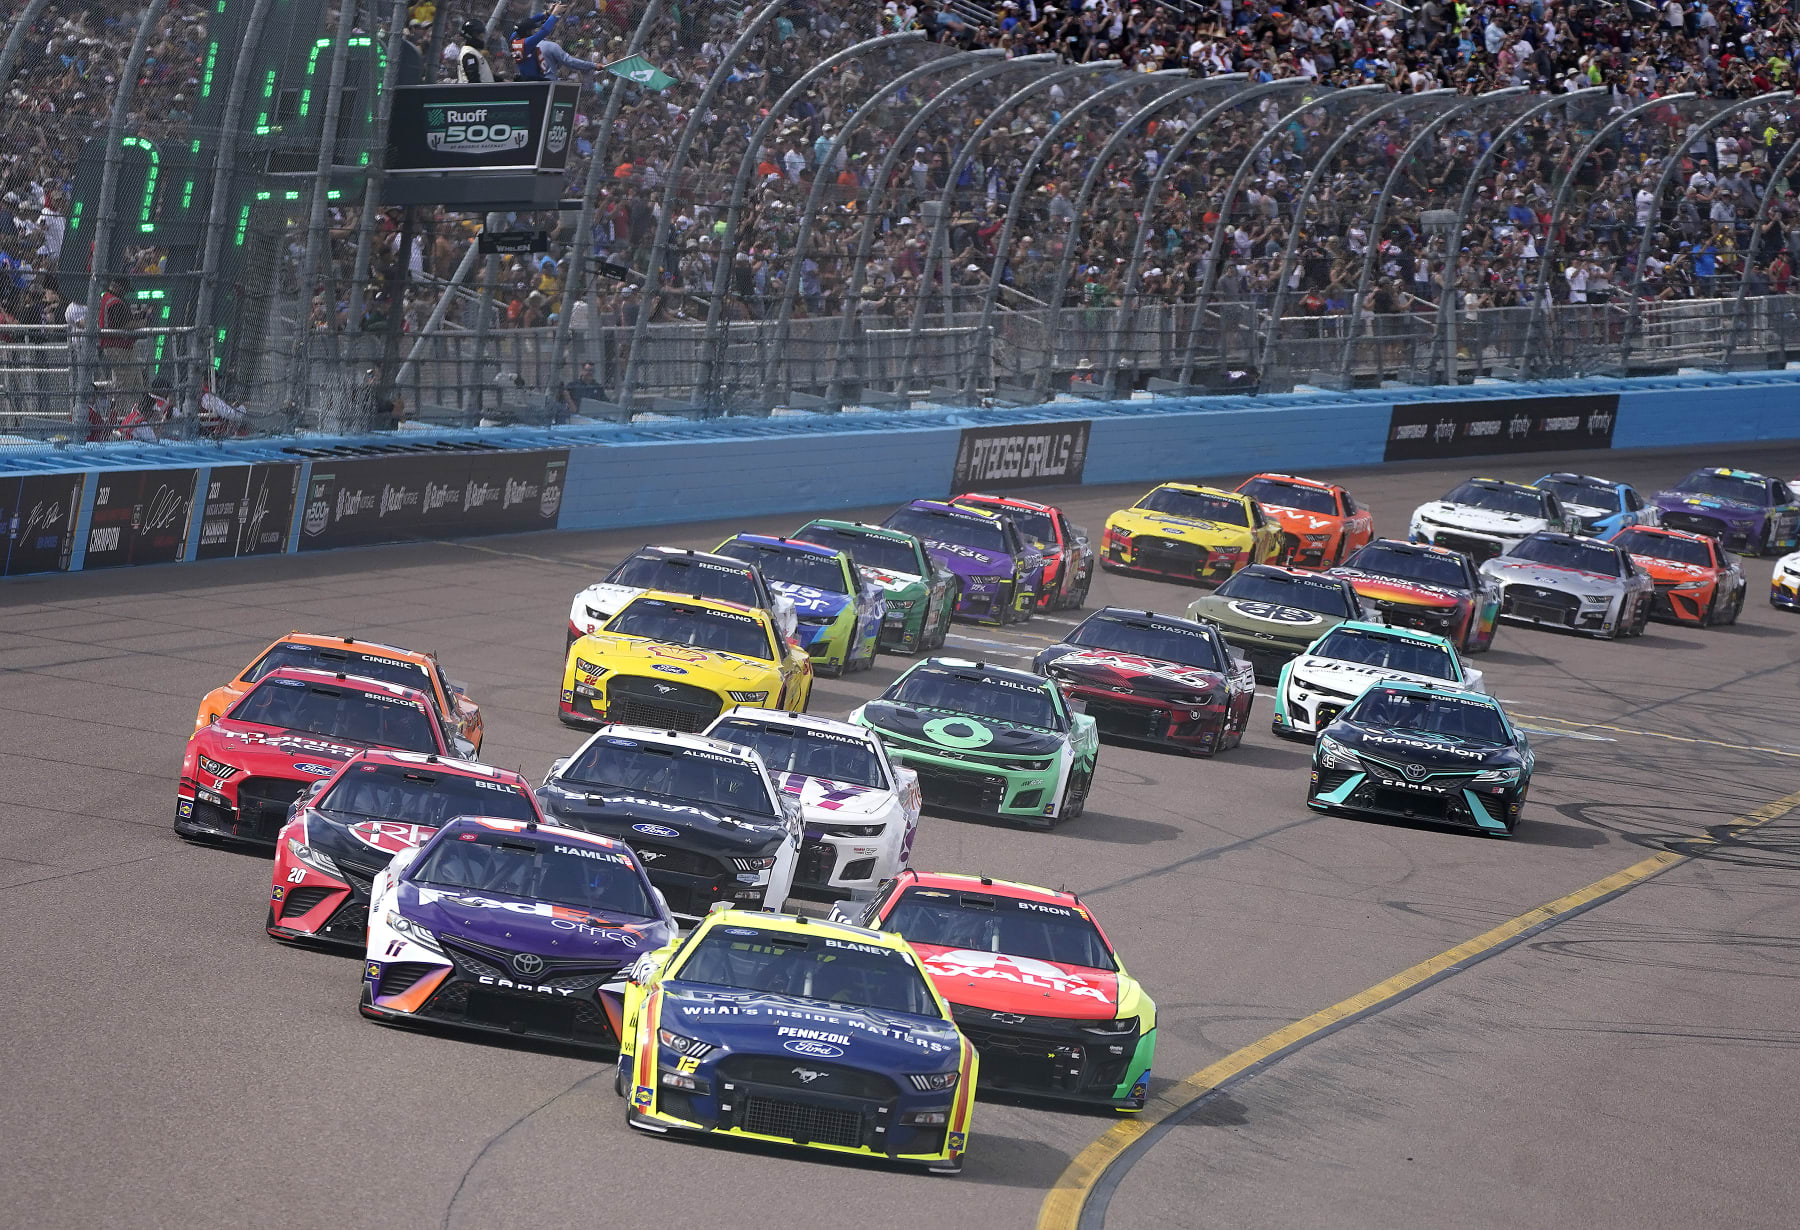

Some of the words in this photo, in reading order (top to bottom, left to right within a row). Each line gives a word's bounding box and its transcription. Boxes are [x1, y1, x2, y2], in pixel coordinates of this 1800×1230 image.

[447, 109, 488, 123] Ruoff
[446, 124, 512, 142] 500
[1020, 434, 1072, 478] GRILLS
[1000, 504, 1032, 514] TRUEX
[949, 512, 996, 525] KESELOWSK
[865, 533, 907, 544] HARVICK
[802, 554, 838, 566] JONES
[698, 562, 748, 576] REDDICK
[1373, 579, 1413, 590] meets
[1416, 588, 1445, 600] next
[706, 609, 752, 623] LOGANO
[586, 624, 596, 634] 8
[1400, 638, 1439, 650] ELLIOTT
[362, 655, 412, 670] CINDRIC
[657, 664, 682, 674] Ford
[584, 674, 599, 686] 22
[982, 676, 996, 685] A.
[999, 679, 1046, 695] DILLON
[364, 692, 417, 708] BRISCOE
[1297, 693, 1308, 701] 9
[1431, 694, 1458, 703] KURT
[1460, 699, 1495, 711] BUSCH
[807, 730, 865, 746] BOWMAN
[1362, 734, 1483, 761] MoneyLion
[682, 750, 750, 767] ALMIROLA
[1320, 754, 1336, 769] 45
[303, 764, 333, 775] Ford
[212, 779, 226, 790] 14
[475, 781, 517, 794] BELL
[1383, 779, 1447, 793] CAMRY
[638, 825, 672, 836] Ford
[554, 845, 624, 865] HAMLIN
[287, 867, 307, 884] 20
[418, 888, 645, 939] FedEx
[1018, 902, 1070, 917] BYRON
[551, 919, 638, 948] Office
[385, 939, 408, 957] 11
[825, 939, 892, 957] BLANEY
[479, 975, 575, 997] CAMRY
[923, 964, 1113, 1004] AXALTA
[682, 1005, 758, 1016] WHAT'S
[767, 1008, 840, 1025] INSIDE
[777, 1026, 851, 1046] PENNZOIL
[794, 1040, 834, 1056] Ford
[675, 1055, 701, 1074] 12
